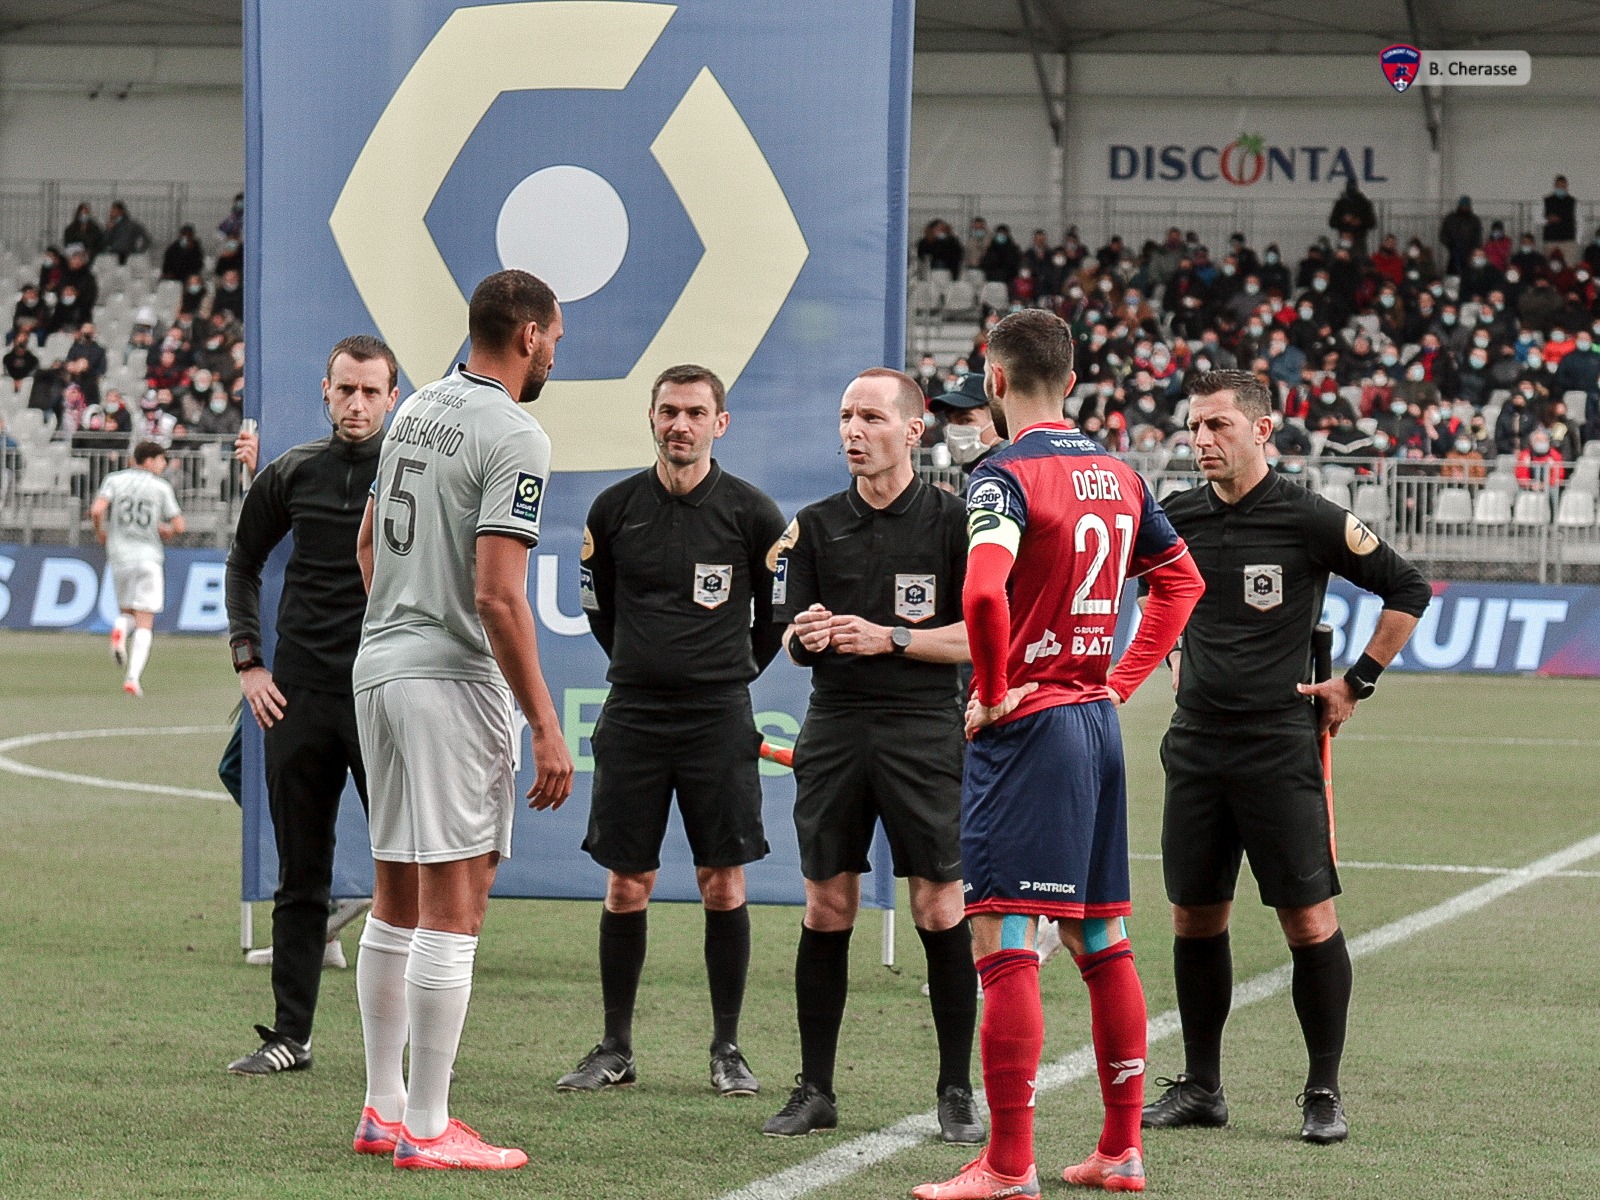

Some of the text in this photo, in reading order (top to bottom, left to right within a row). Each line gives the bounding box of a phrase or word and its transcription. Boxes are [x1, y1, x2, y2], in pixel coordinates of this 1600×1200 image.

[1109, 139, 1388, 186] DISCONTAL
[389, 416, 464, 457] BDELHAMID
[1071, 463, 1123, 501] OGIER
[118, 498, 151, 527] 35
[384, 457, 427, 556] 5
[1070, 513, 1134, 615] 21
[1032, 881, 1076, 894] PATRICK
